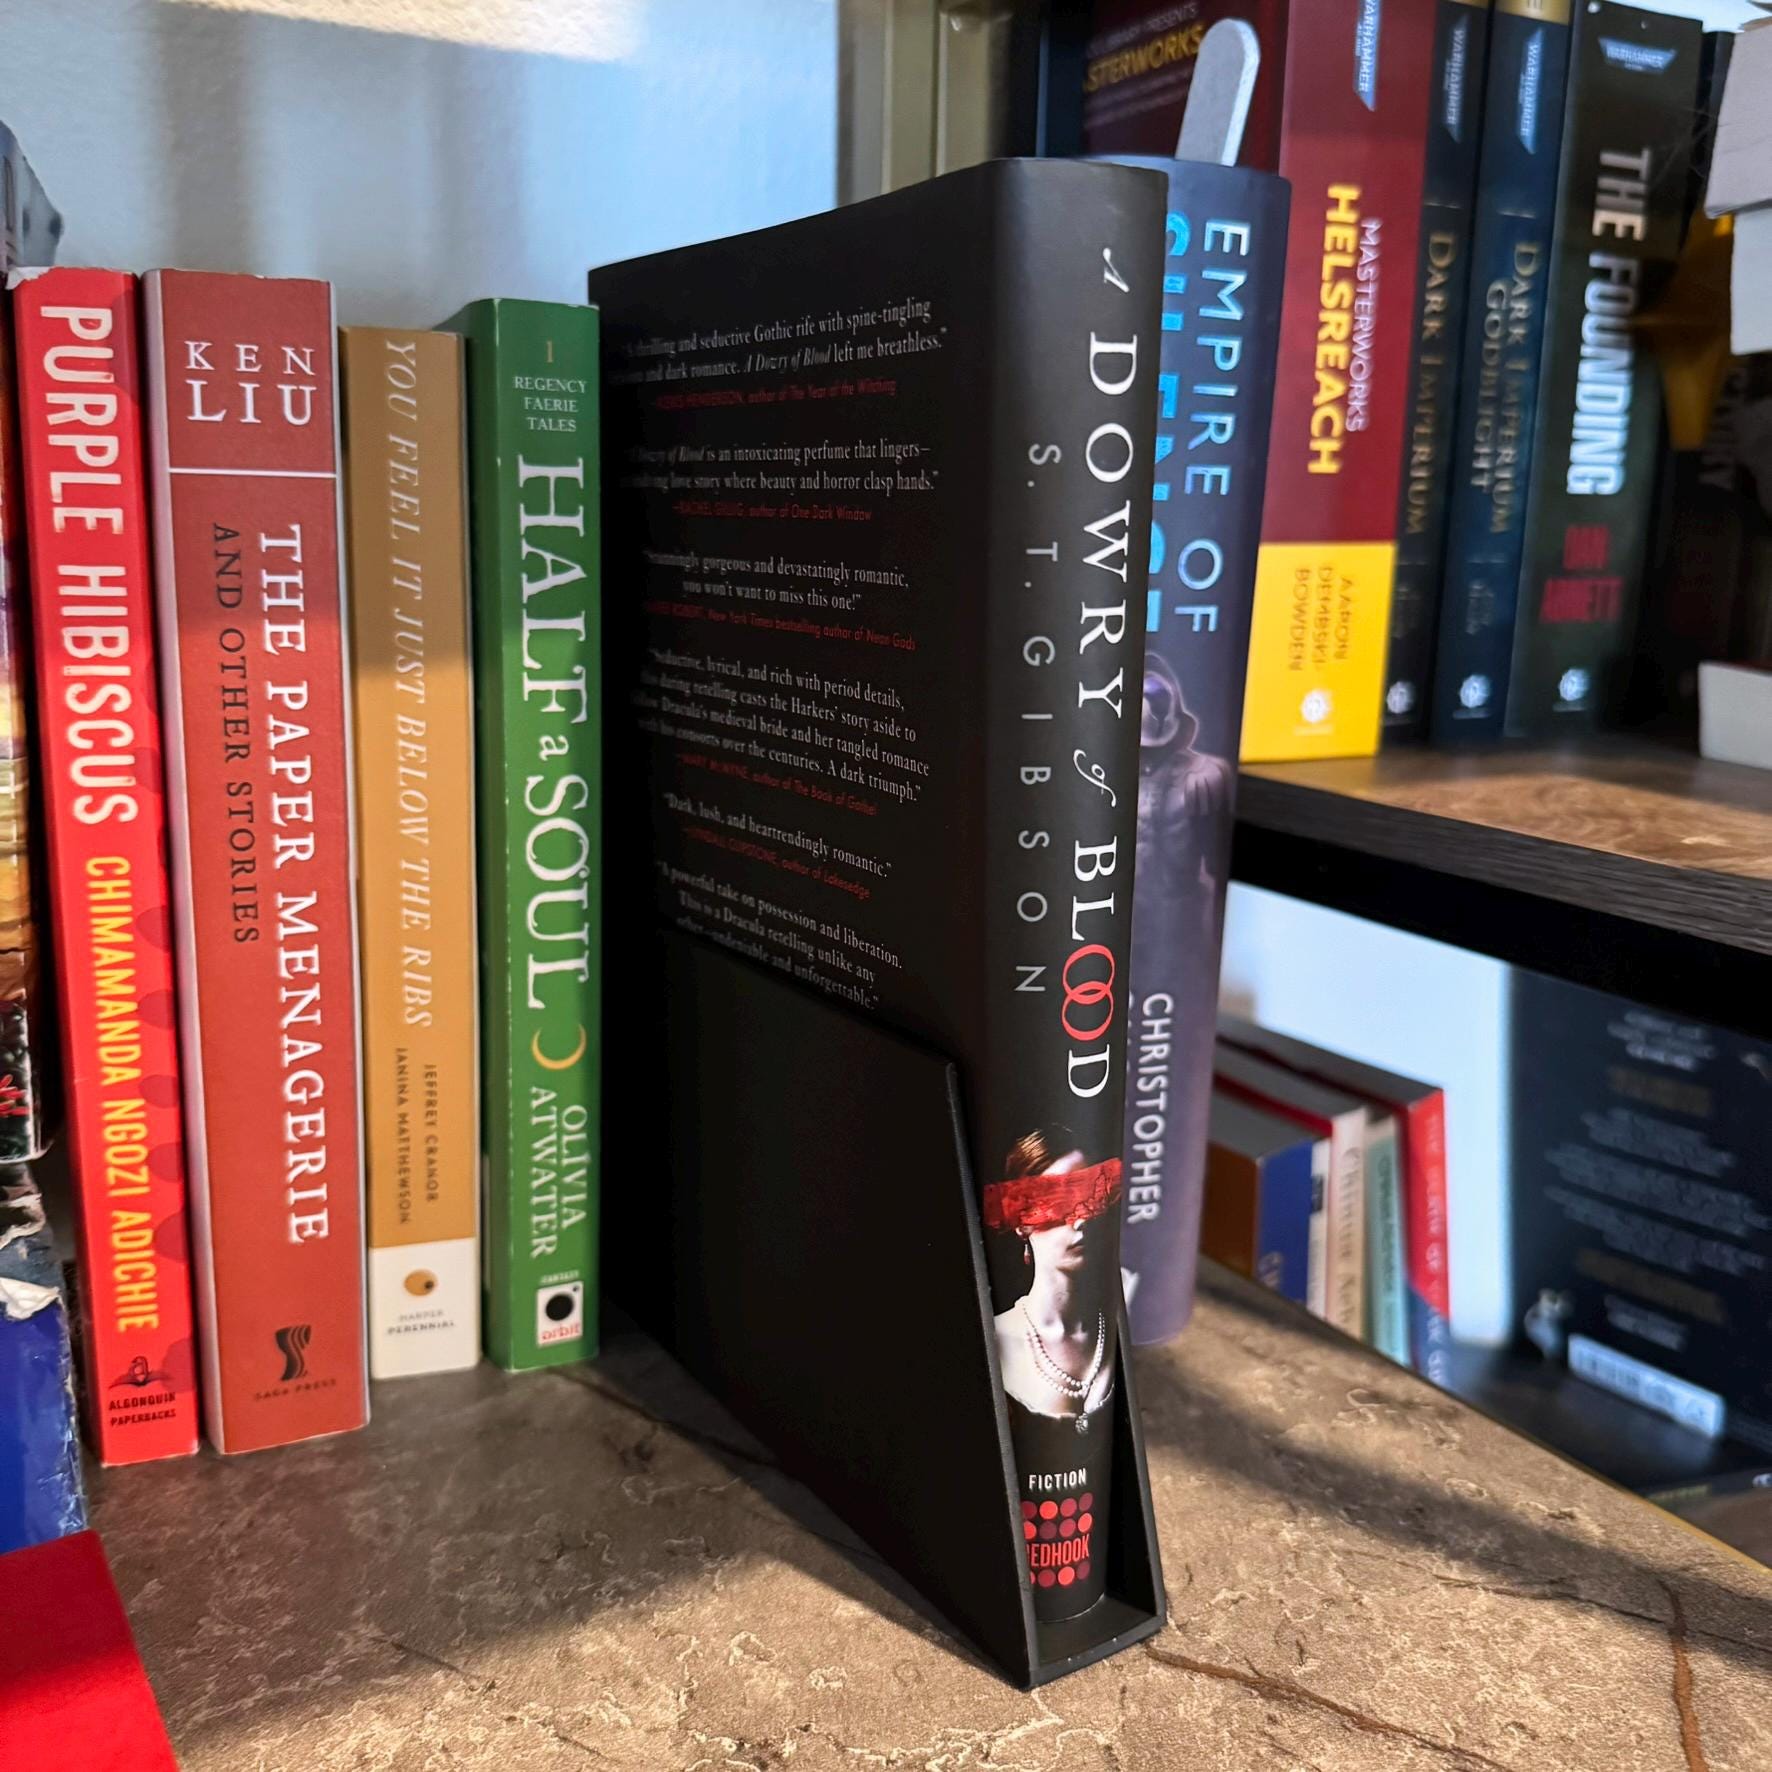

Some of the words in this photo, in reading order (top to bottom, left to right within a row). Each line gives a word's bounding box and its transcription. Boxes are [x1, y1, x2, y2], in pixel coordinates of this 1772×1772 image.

[1358, 0, 1377, 92] ARHAMMER
[1592, 148, 1650, 242] THE
[699, 328, 751, 350] seductive
[753, 319, 793, 343] Gothic
[796, 314, 816, 338] rife
[818, 309, 845, 333] with
[846, 296, 932, 336] spine-tingling
[1307, 183, 1363, 475] HELSREACH
[1345, 216, 1384, 432] MASTERWORKS
[1422, 231, 1455, 341] DARK
[1508, 240, 1543, 346] DARK
[184, 340, 316, 376] KEN
[385, 340, 418, 423] YOU
[514, 376, 587, 394] REGENCY
[690, 361, 741, 379] romance.
[834, 339, 854, 363] left
[856, 344, 875, 361] me
[1183, 218, 1251, 497] EMPIRE
[1471, 277, 1509, 494] GODBLIGHT
[1566, 252, 1639, 495] FOUNDING
[40, 305, 125, 535] PURPLE
[185, 379, 318, 426] LIU
[524, 397, 579, 413] FAERIE
[527, 417, 577, 433] TALES
[1406, 353, 1444, 535] IMPERIUM
[1489, 356, 1531, 534] IMPERIUM
[388, 432, 421, 542] FEEL
[718, 446, 732, 462] an
[733, 440, 801, 467] intoxicating
[803, 440, 851, 467] perfume
[853, 439, 877, 459] that
[724, 471, 757, 489] where
[759, 470, 797, 497] beauty
[800, 470, 820, 490] and
[823, 470, 861, 490] horror
[863, 470, 894, 498] clasp
[1027, 443, 1062, 488] S.
[213, 522, 243, 610] AND
[1024, 541, 1058, 589] T.
[1078, 331, 1138, 719] DOWRY
[258, 523, 307, 656] THE
[391, 556, 424, 601] IT
[518, 454, 587, 724] HALF
[702, 556, 752, 576] gorgeous
[753, 555, 775, 574] and
[777, 555, 851, 588] devastatingly
[736, 584, 763, 600] want
[764, 587, 776, 601] to
[779, 584, 805, 604] miss
[807, 586, 829, 607] this
[1173, 537, 1224, 634] OF
[57, 564, 140, 826] HIBISCUS
[218, 627, 252, 765] OTHER
[394, 606, 426, 705] JUST
[747, 663, 768, 682] and
[769, 665, 793, 687] rich
[795, 670, 821, 692] with
[824, 677, 862, 700] period
[539, 734, 570, 762] a
[759, 714, 789, 738] bride
[791, 725, 813, 744] and
[814, 726, 835, 749] her
[836, 738, 880, 763] tangled
[881, 750, 931, 778] romance
[770, 691, 789, 712] the
[840, 710, 871, 738] story
[872, 715, 902, 739] aside
[904, 726, 917, 744] to
[266, 679, 317, 870] PAPER
[396, 713, 430, 847] BELOW
[748, 739, 767, 759] the
[768, 748, 825, 774] centuries.
[827, 758, 838, 778] A
[839, 760, 866, 786] dark
[1073, 749, 1117, 809] of
[727, 813, 747, 830] and
[748, 815, 829, 862] heartrendingly
[1014, 635, 1056, 993] GIBSON
[226, 781, 260, 944] STORIES
[400, 858, 432, 931] THE
[524, 774, 590, 1010] SOUL
[85, 855, 142, 1087] CHIMAMANDA
[740, 893, 756, 908] on
[757, 898, 817, 931] possession
[819, 923, 841, 941] and
[843, 926, 903, 969] liberation.
[767, 928, 816, 962] retelling
[817, 947, 853, 973] unlike
[856, 964, 876, 990] any
[1061, 835, 1118, 1099] BLOOD
[402, 944, 434, 1029] RIBS
[276, 890, 330, 1245] MENAGERIE
[424, 1064, 439, 1127] JEFFREY
[1127, 991, 1175, 1224] CHRISTOPHER
[102, 1098, 151, 1198] NGOZI
[397, 1112, 412, 1226] MATTHEWSON
[424, 1134, 440, 1202] CRANOR
[530, 1086, 558, 1259] ATWATER
[561, 1104, 591, 1230] OLIVIA
[110, 1209, 160, 1333] ADICHIE
[387, 1320, 455, 1336] PERENNIAL
[541, 1323, 580, 1342] orbit
[108, 1391, 176, 1411] ALGONQUIN
[110, 1408, 177, 1427] PAPERBACKS
[1028, 1467, 1088, 1490] FICTION
[1026, 1533, 1090, 1567] EDHOOK
